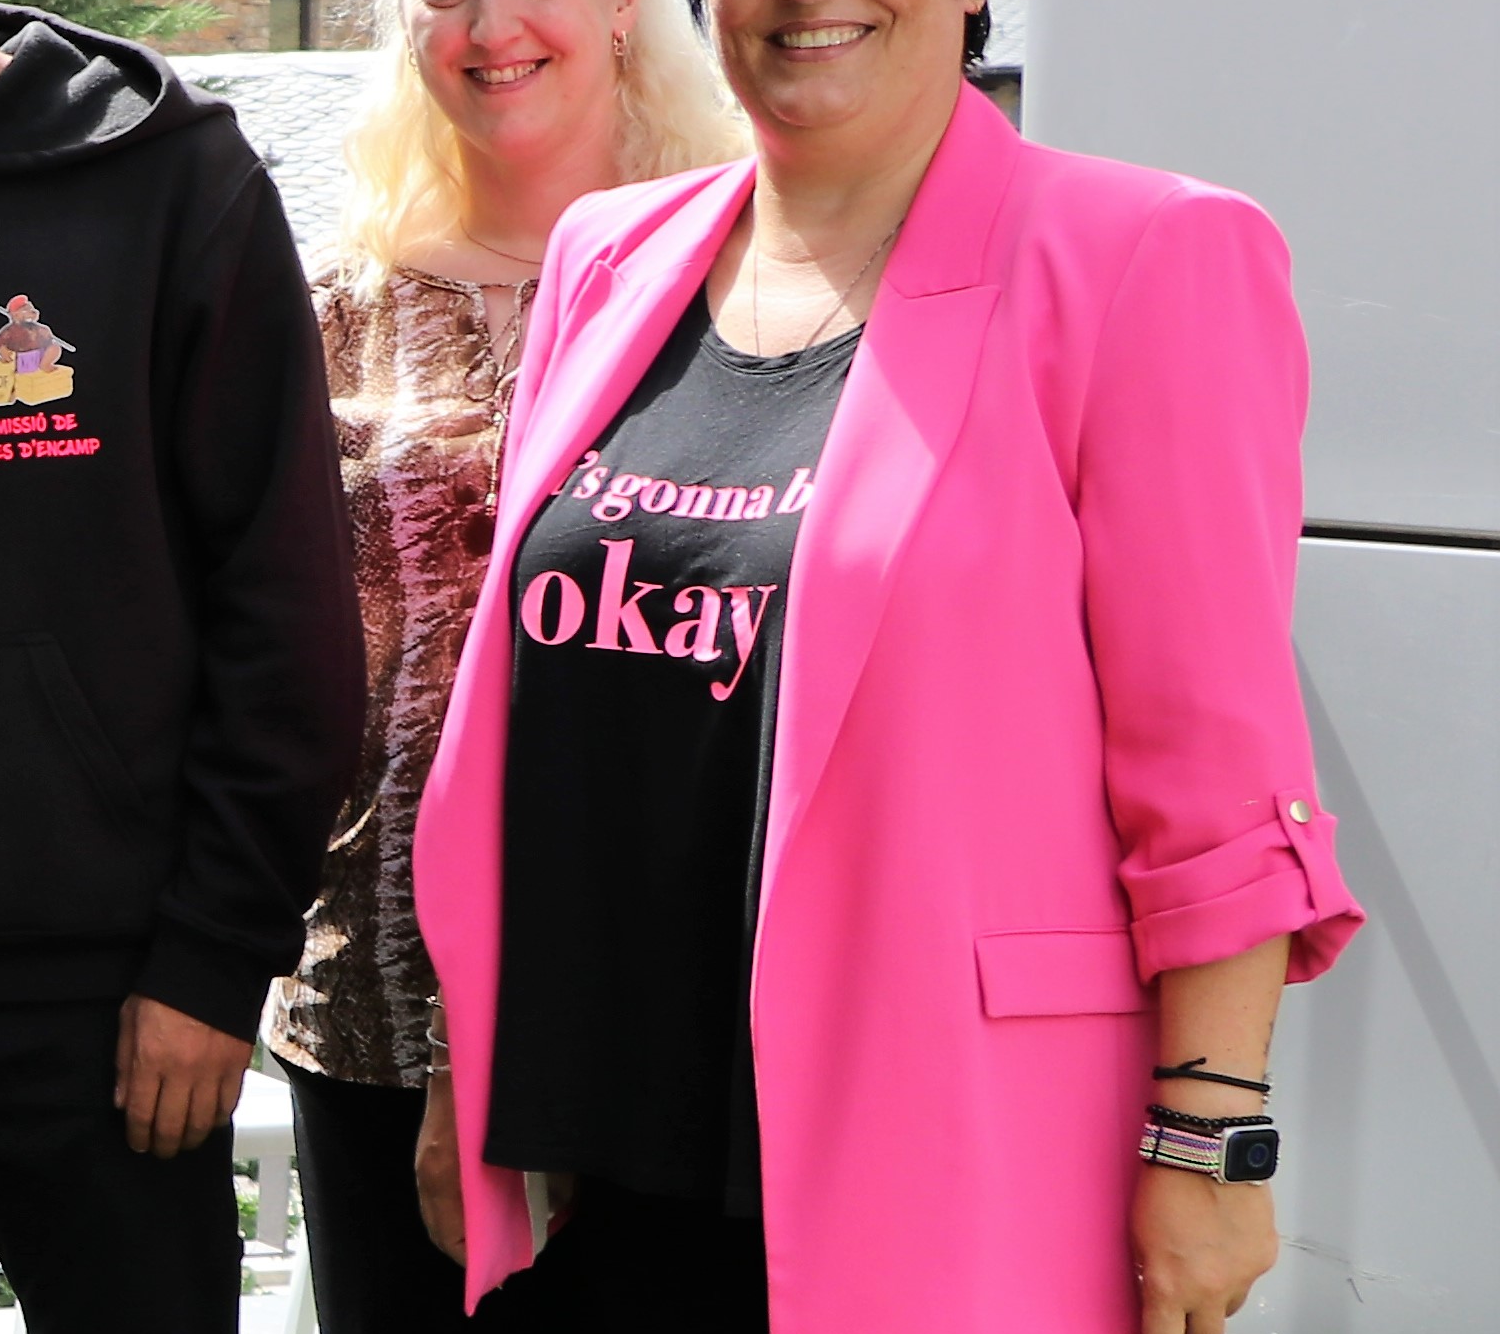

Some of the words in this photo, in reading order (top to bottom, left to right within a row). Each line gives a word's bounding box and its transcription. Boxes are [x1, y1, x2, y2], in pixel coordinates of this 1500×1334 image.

[51, 413, 78, 431] DE
[19, 438, 101, 459] D'ENCAMP
[591, 473, 775, 522] gonna
[521, 538, 778, 702] okay
